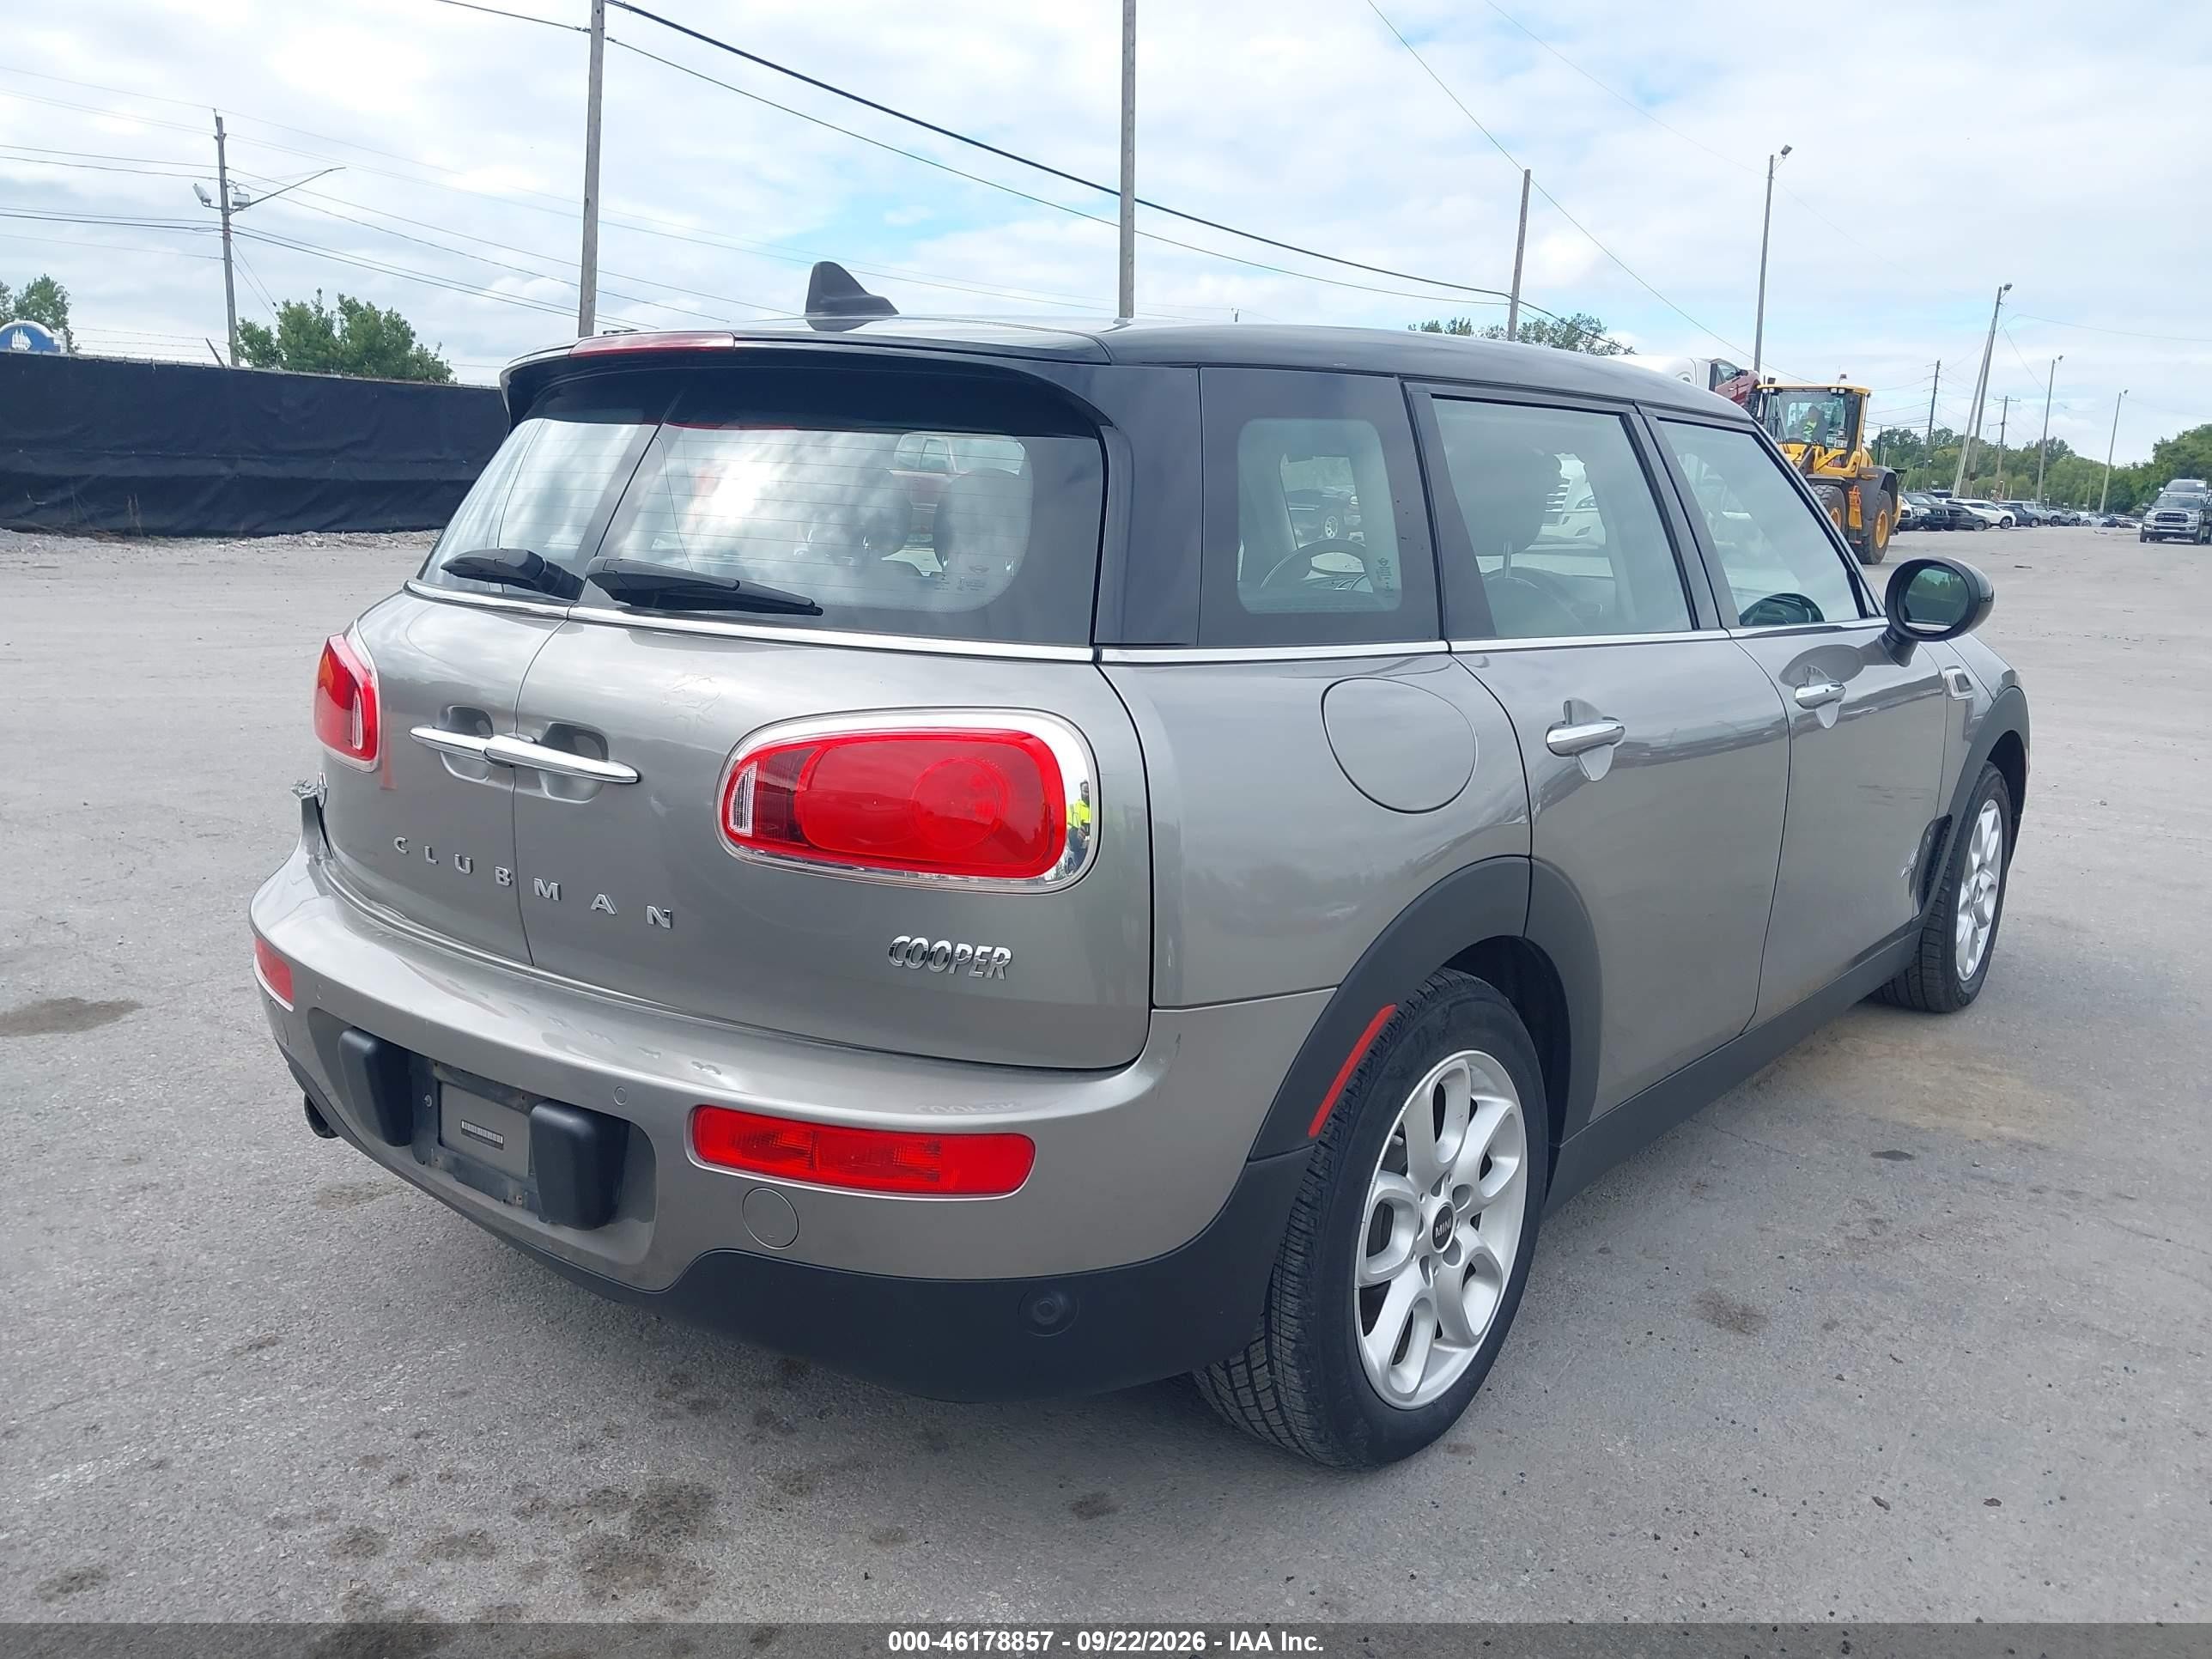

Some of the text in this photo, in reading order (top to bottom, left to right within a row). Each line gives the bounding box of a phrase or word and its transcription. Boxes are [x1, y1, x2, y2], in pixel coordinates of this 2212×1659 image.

[393, 836, 673, 929] CLUBMAN
[888, 935, 1012, 980] COOPER
[1435, 1216, 1452, 1238] MINI
